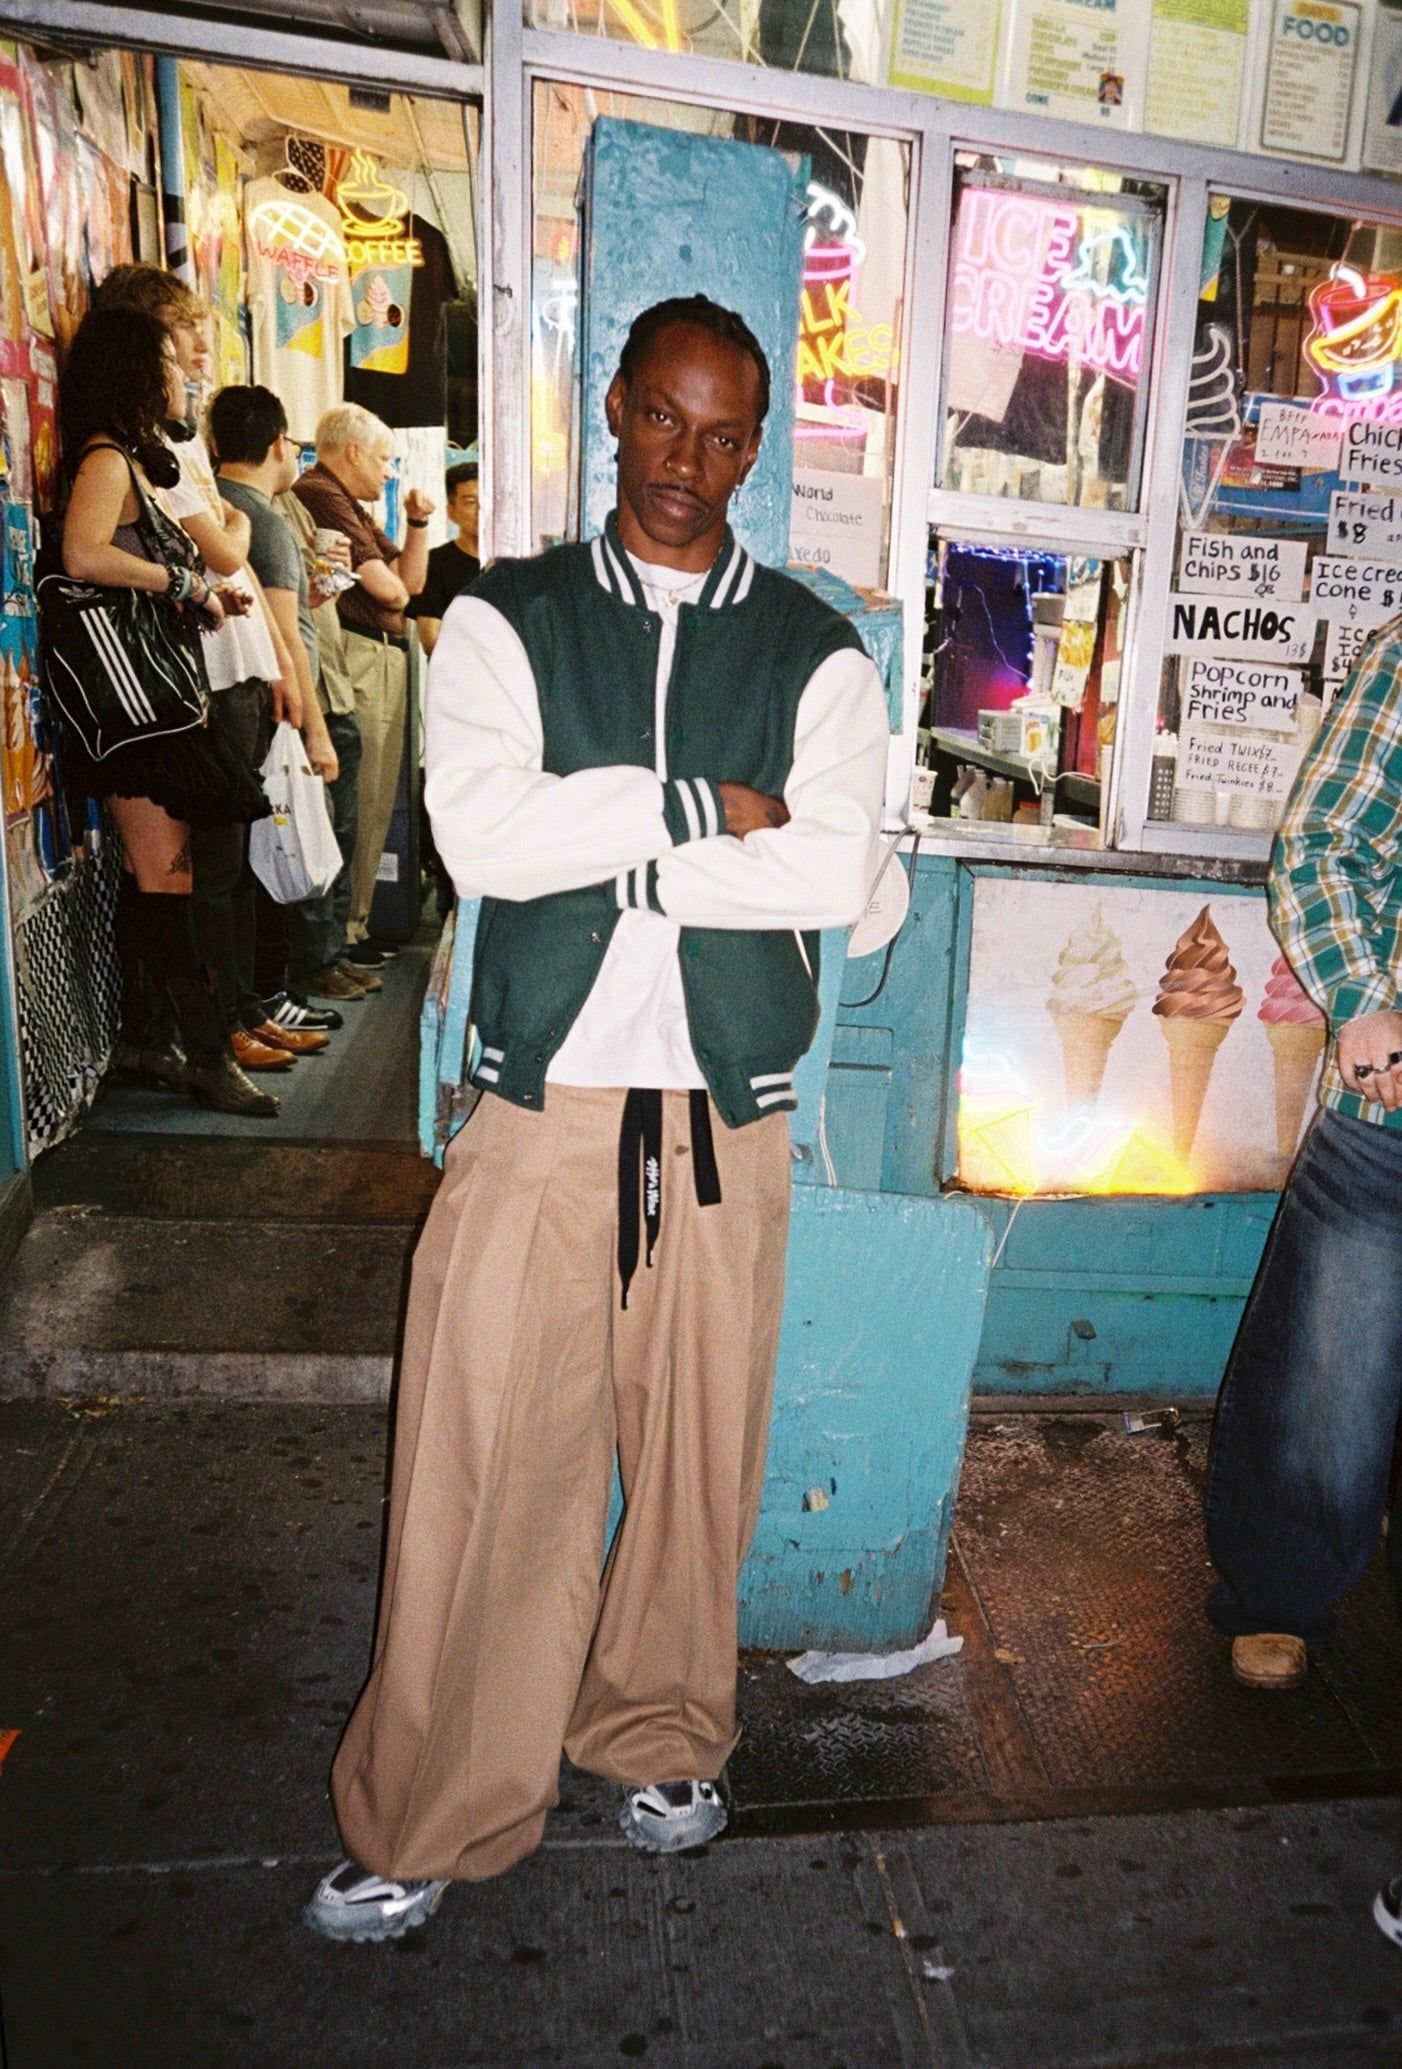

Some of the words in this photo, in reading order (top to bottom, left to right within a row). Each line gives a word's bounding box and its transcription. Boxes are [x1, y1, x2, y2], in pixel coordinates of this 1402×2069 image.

[1283, 15, 1350, 47] FOOD
[963, 190, 1078, 284] ICE
[257, 239, 340, 278] WAFFLE
[343, 240, 425, 265] OFFEE
[800, 280, 862, 334] LK
[951, 264, 1145, 374] CREAM
[797, 324, 899, 383] AKES
[806, 505, 863, 527] Chocolate
[1335, 495, 1395, 523] Fried
[1337, 520, 1368, 544] $8
[1188, 536, 1234, 560] Fish
[1240, 543, 1279, 561] and
[1185, 560, 1241, 581] Chips
[1247, 562, 1281, 582] $16
[1317, 562, 1358, 581] Ice
[1172, 603, 1296, 642] NACHOS
[1191, 660, 1289, 691] Popcorn
[1190, 684, 1256, 705] Shrimp
[1260, 692, 1298, 710] and
[1188, 700, 1247, 723] Fries
[1189, 737, 1223, 753] Fried
[1188, 753, 1219, 767] FRIED
[1185, 768, 1211, 781] Fried
